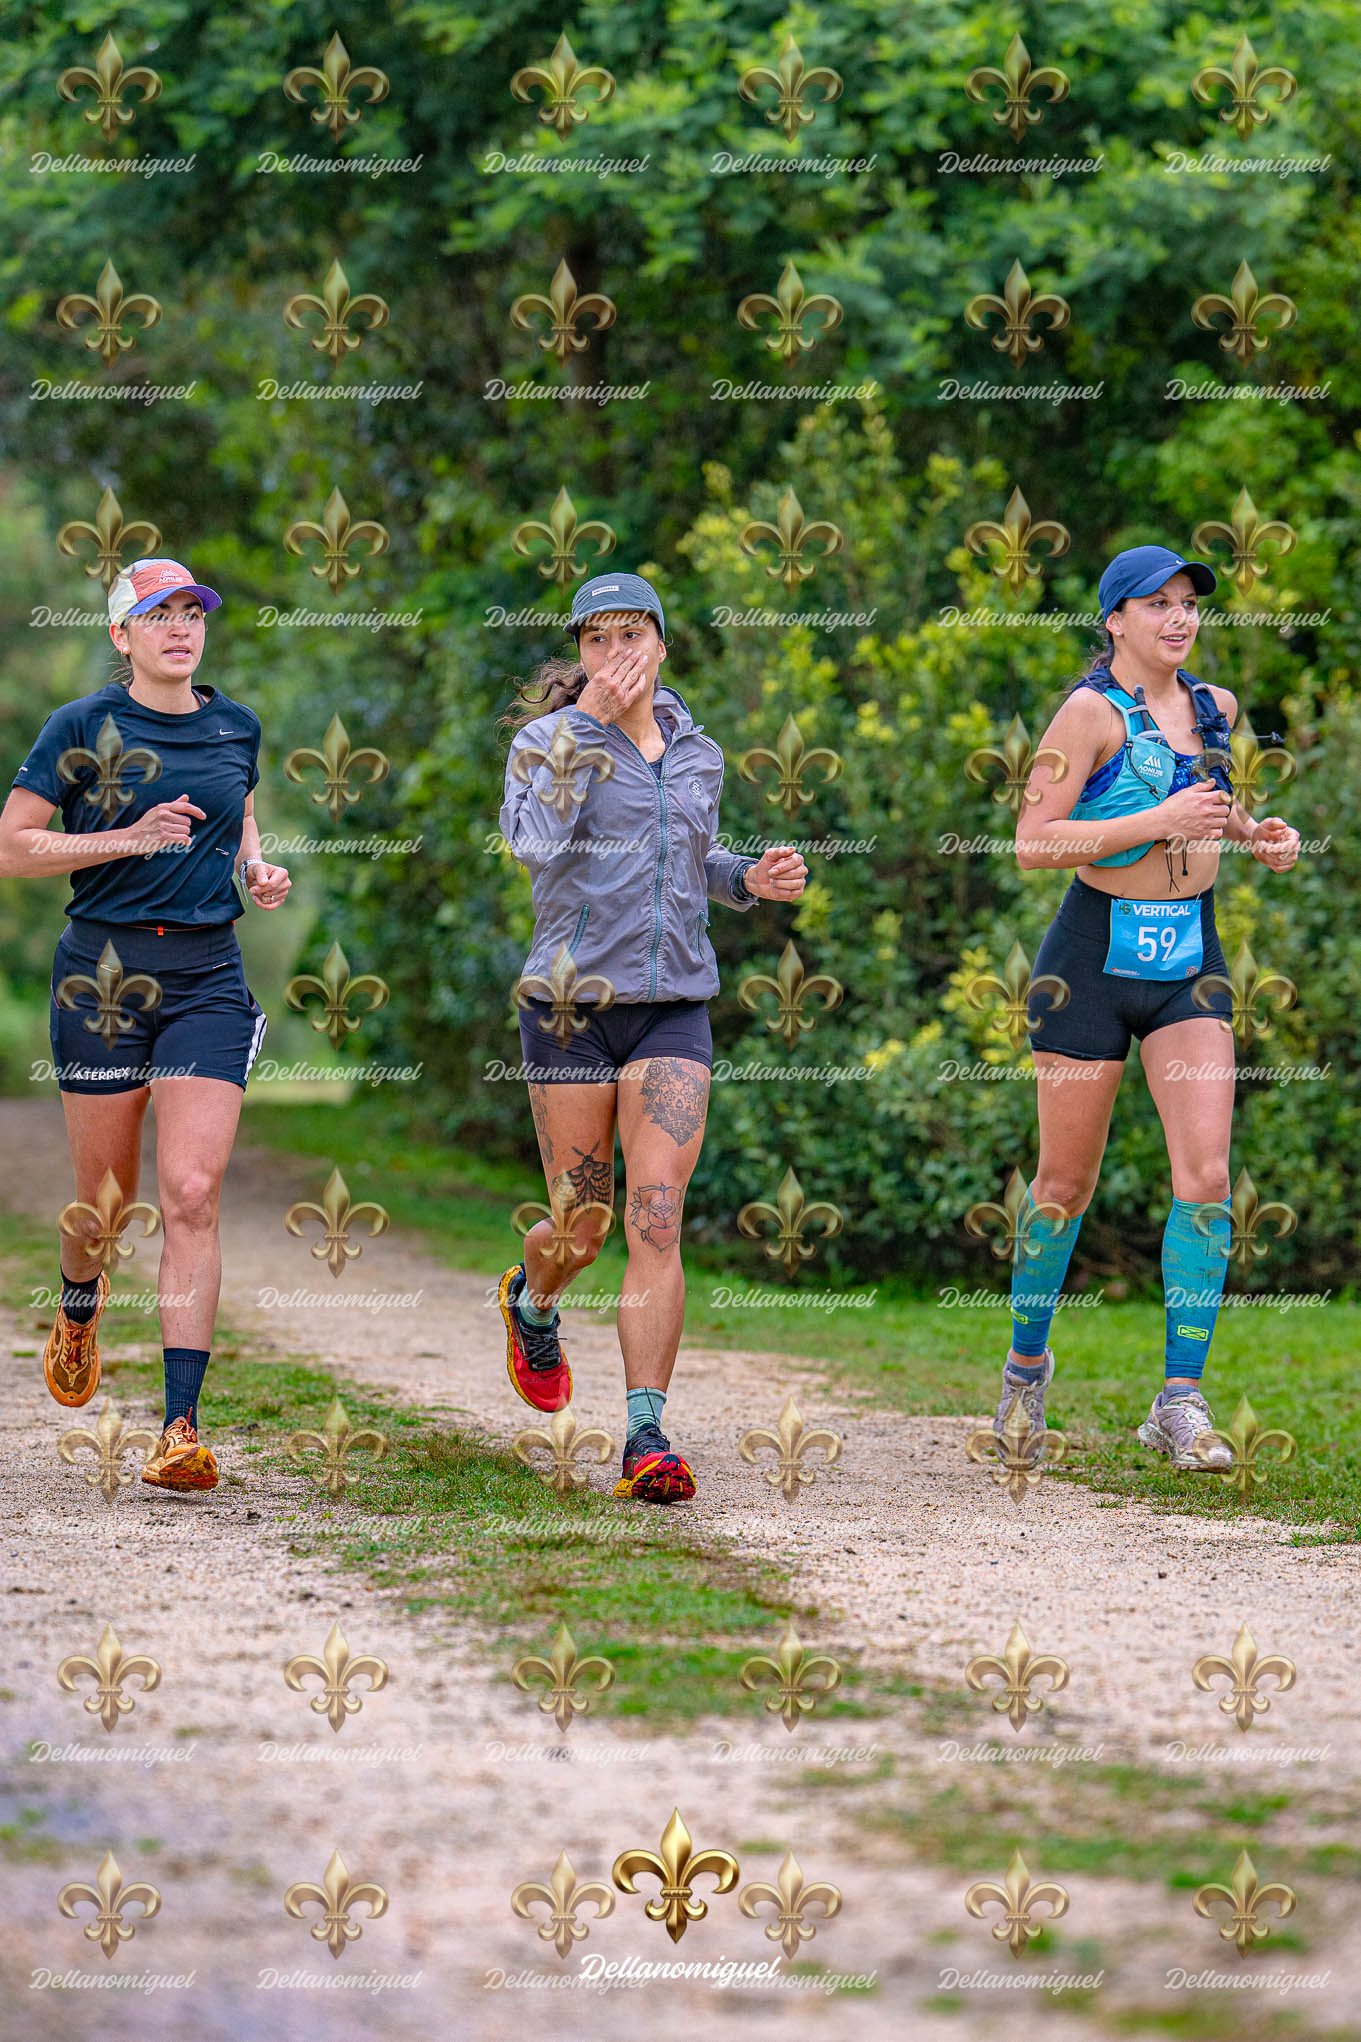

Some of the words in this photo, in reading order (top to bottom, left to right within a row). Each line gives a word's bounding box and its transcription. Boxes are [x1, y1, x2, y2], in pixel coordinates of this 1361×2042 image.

[1133, 904, 1191, 917] VERTICAL
[1137, 926, 1177, 962] 59
[84, 1066, 129, 1081] TERREX
